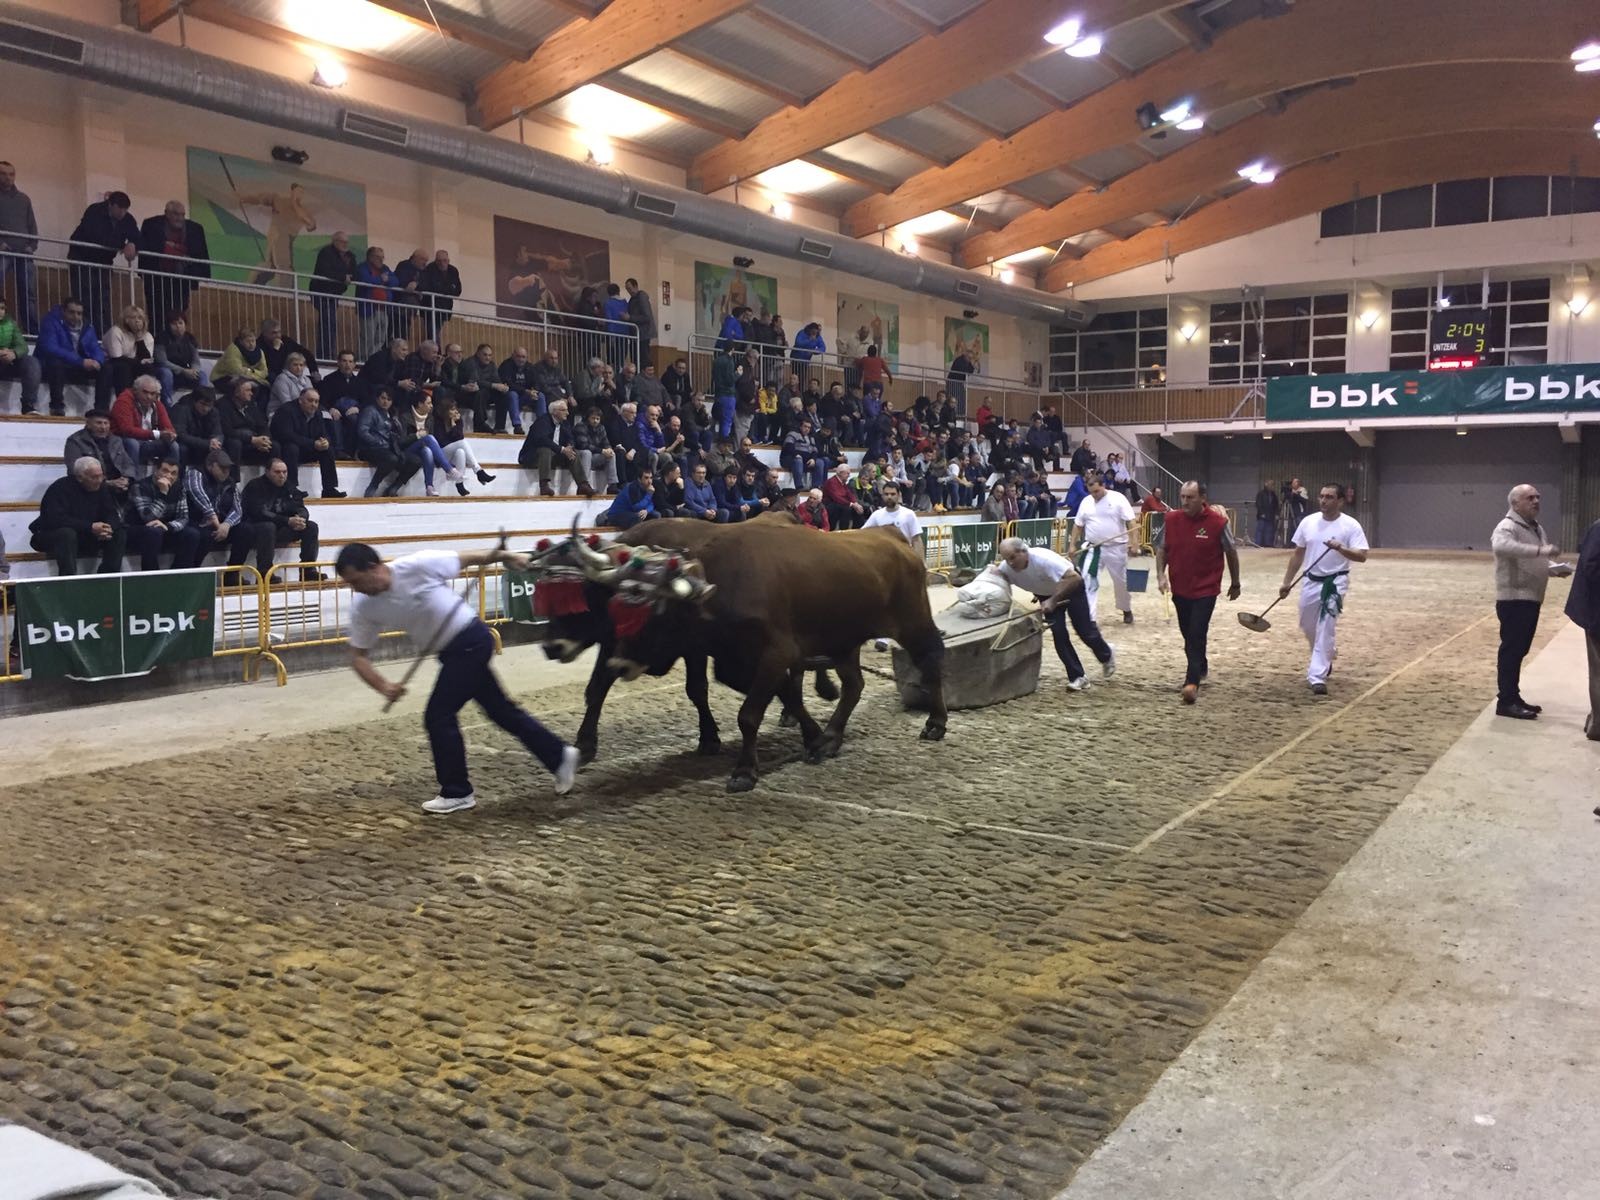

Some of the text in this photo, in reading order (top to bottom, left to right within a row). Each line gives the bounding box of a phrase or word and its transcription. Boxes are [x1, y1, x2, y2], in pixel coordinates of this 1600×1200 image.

[1446, 323, 1485, 337] 2:04
[1433, 339, 1484, 352] UNTZEAK 3
[1310, 383, 1398, 408] bbk
[1505, 375, 1600, 401] bbk
[511, 581, 536, 598] bb
[27, 619, 101, 645] bbk
[129, 611, 196, 636] bbk
